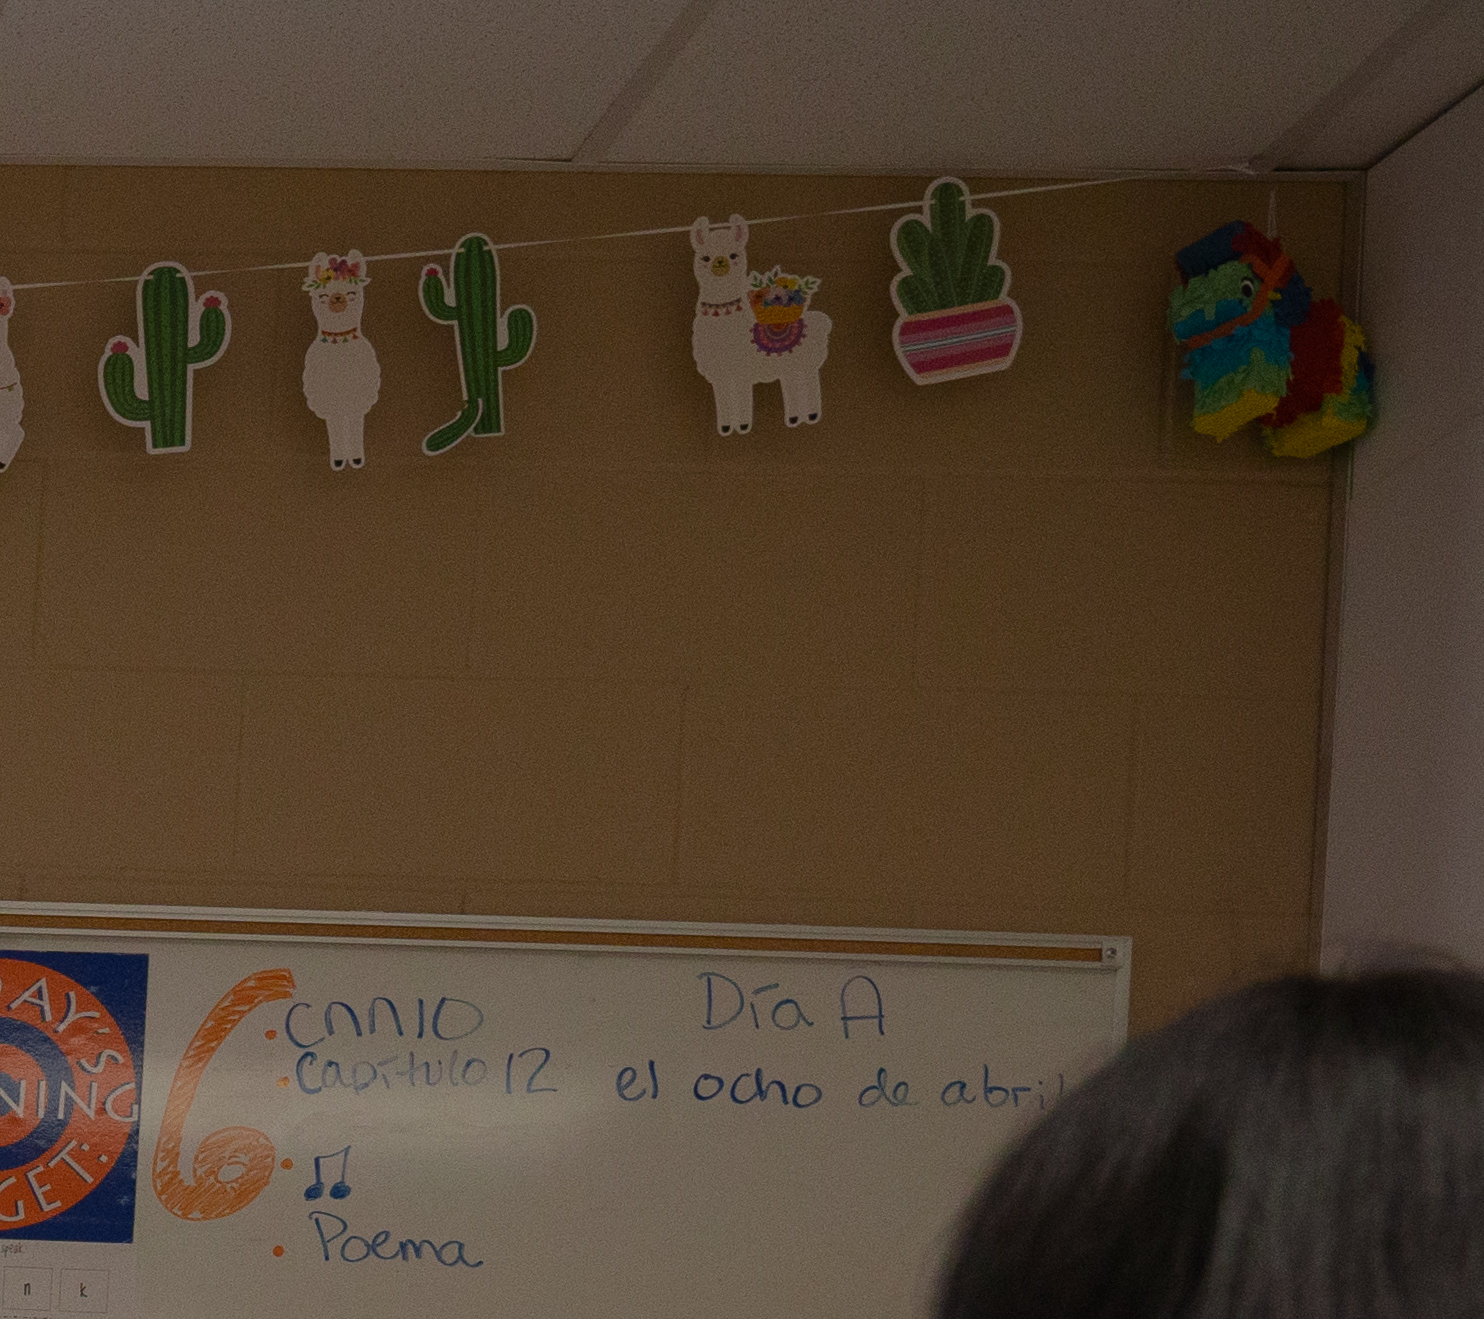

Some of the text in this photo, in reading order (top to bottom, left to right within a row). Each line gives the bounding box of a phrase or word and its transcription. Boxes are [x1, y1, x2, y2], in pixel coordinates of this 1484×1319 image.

[698, 971, 885, 1039] Día A
[152, 968, 296, 1221] 6
[505, 1046, 558, 1095] 12
[616, 1060, 658, 1100] el
[693, 1065, 823, 1109] ocho
[858, 1067, 918, 1108] de
[310, 1211, 483, 1268] Poema
